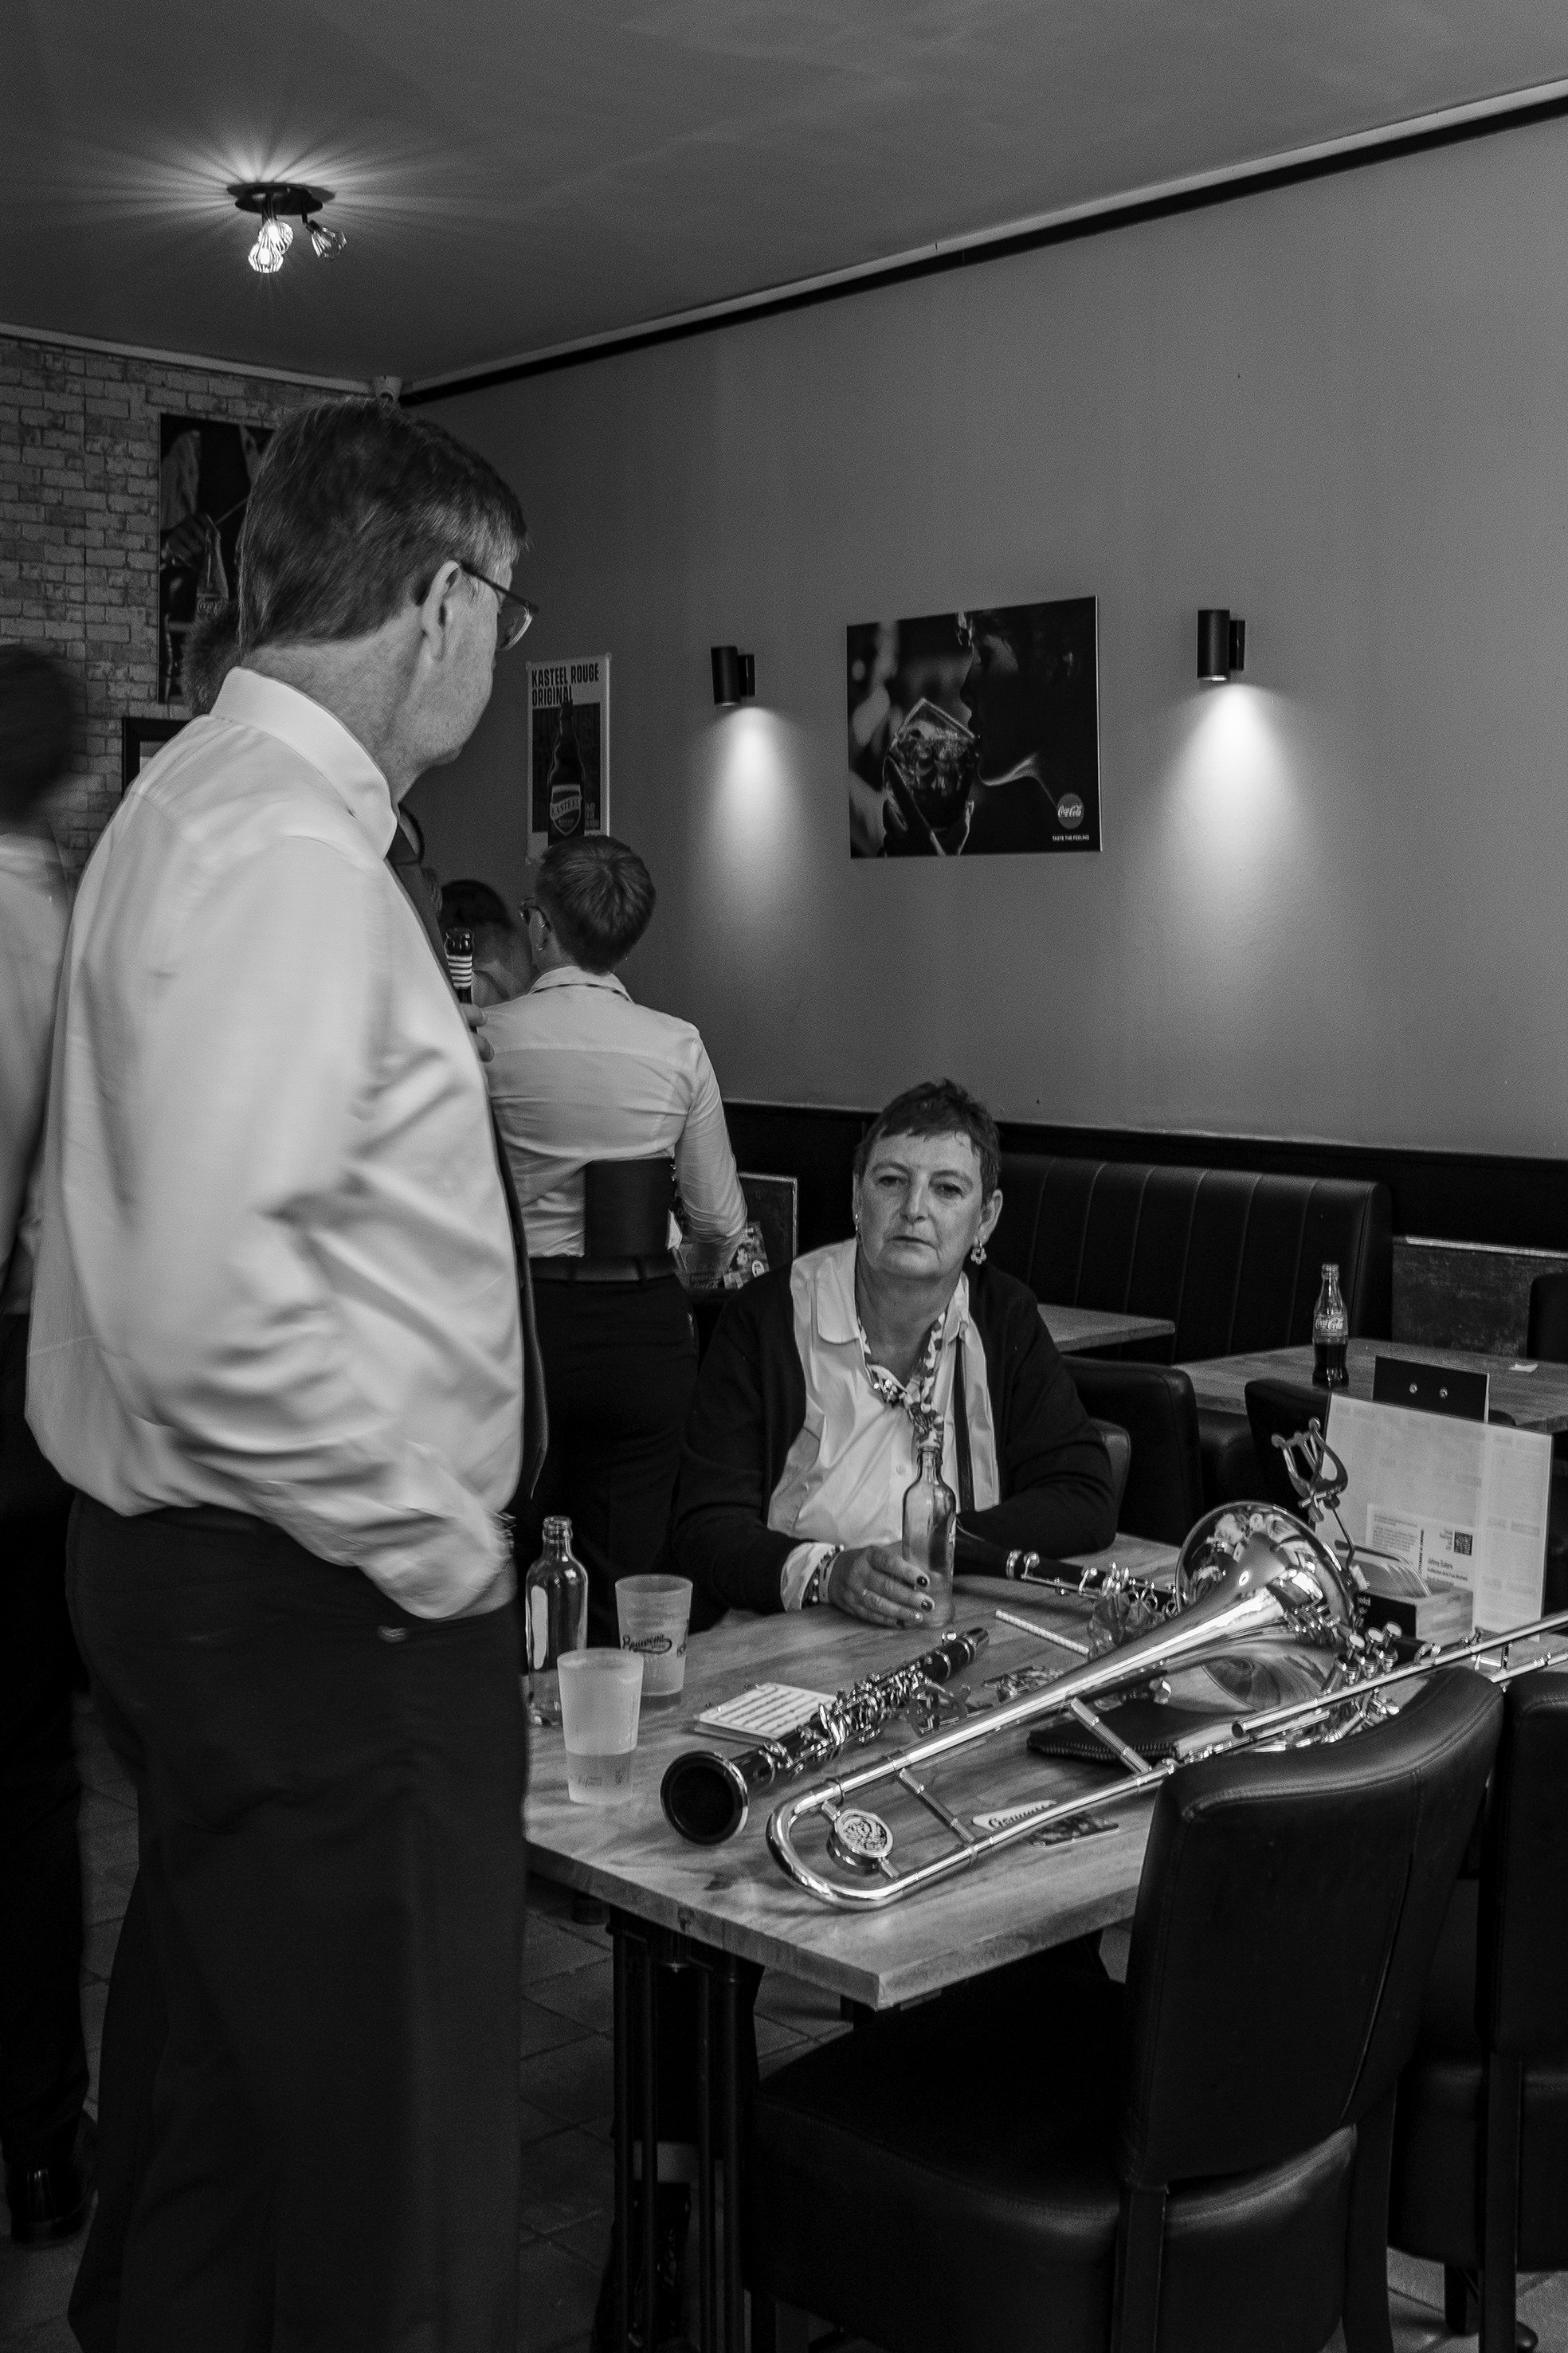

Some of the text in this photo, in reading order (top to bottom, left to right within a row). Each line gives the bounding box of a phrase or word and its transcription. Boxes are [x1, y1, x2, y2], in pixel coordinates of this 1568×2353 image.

[531, 662, 598, 688] KASTEEL ROUGE
[1057, 804, 1082, 818] Coca-Cola
